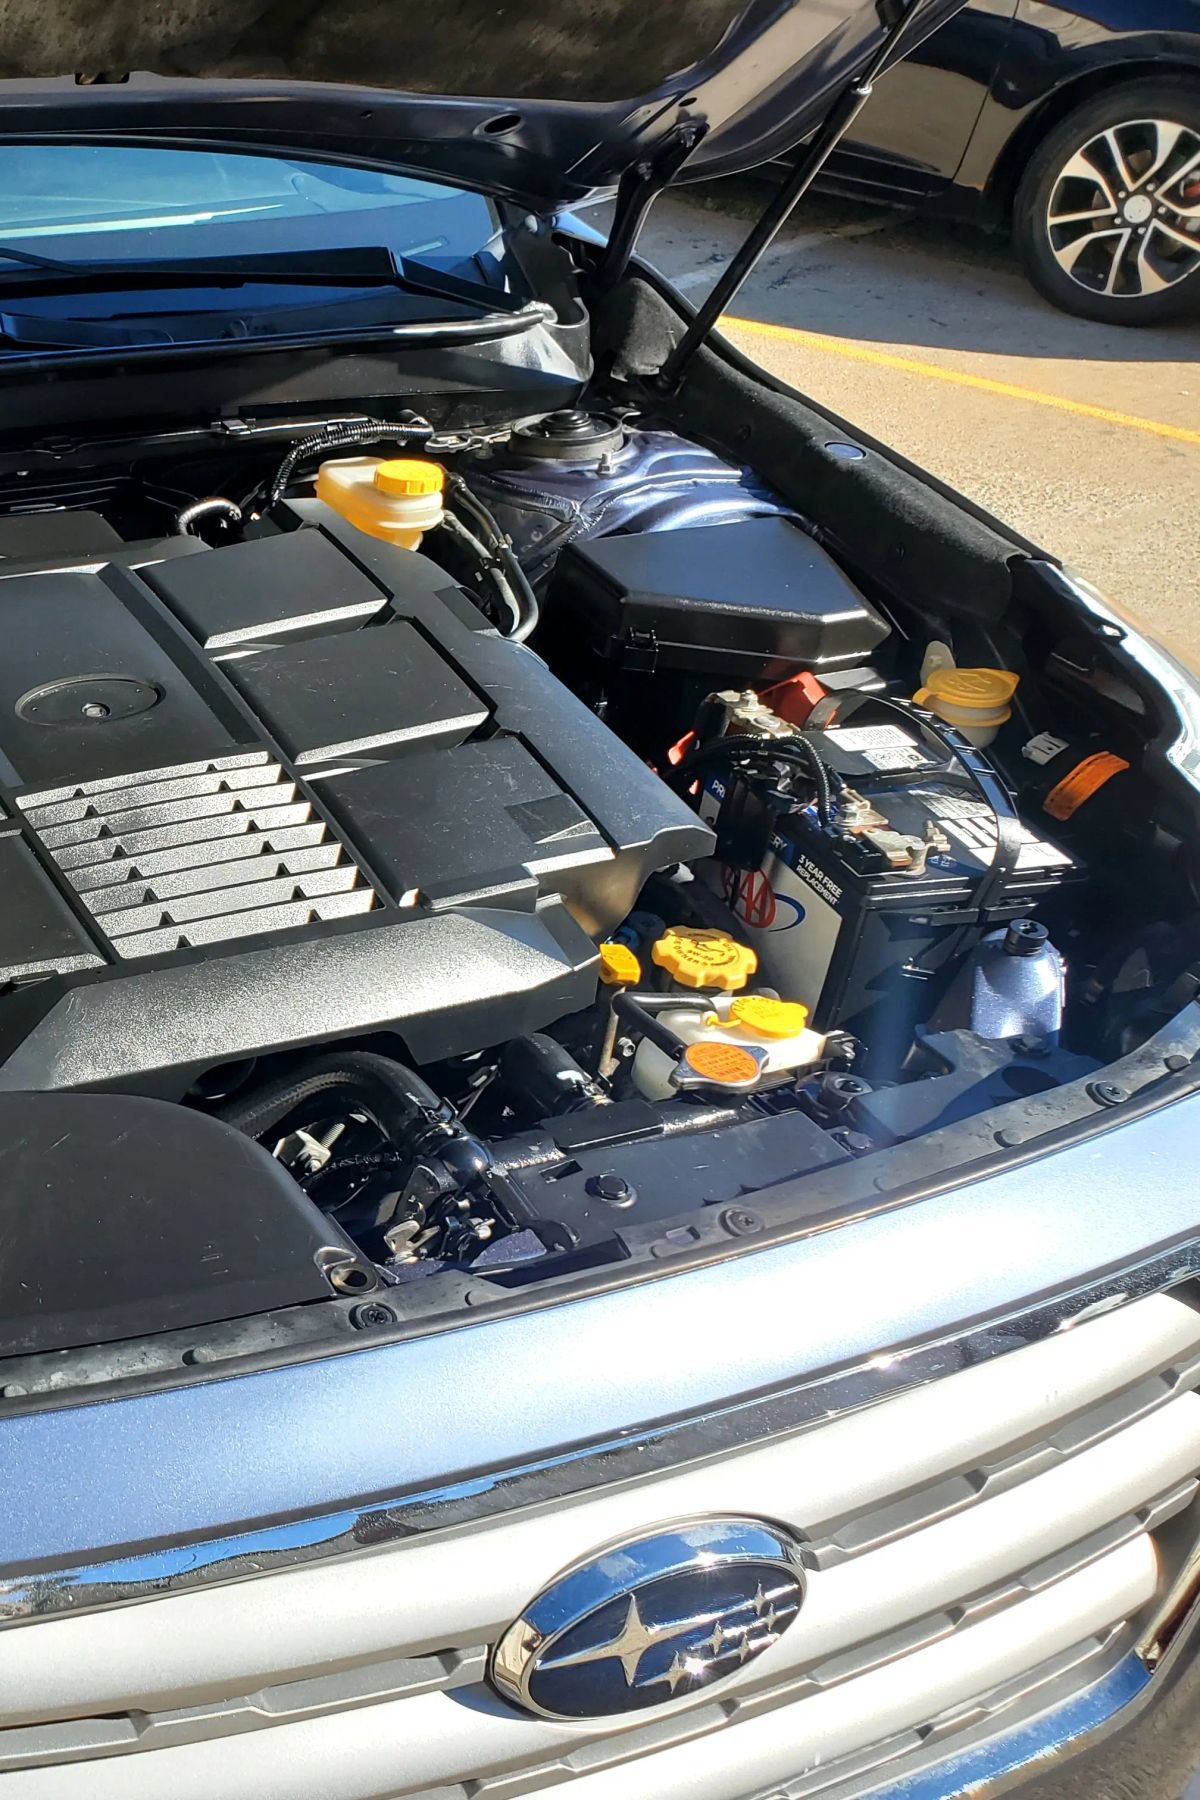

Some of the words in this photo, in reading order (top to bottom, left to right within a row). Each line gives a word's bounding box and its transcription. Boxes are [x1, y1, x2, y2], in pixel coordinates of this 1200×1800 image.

[796, 864, 838, 905] REPLACEMENT
[798, 854, 805, 864] 3
[803, 857, 824, 881] YEAR
[820, 875, 843, 898] FREE
